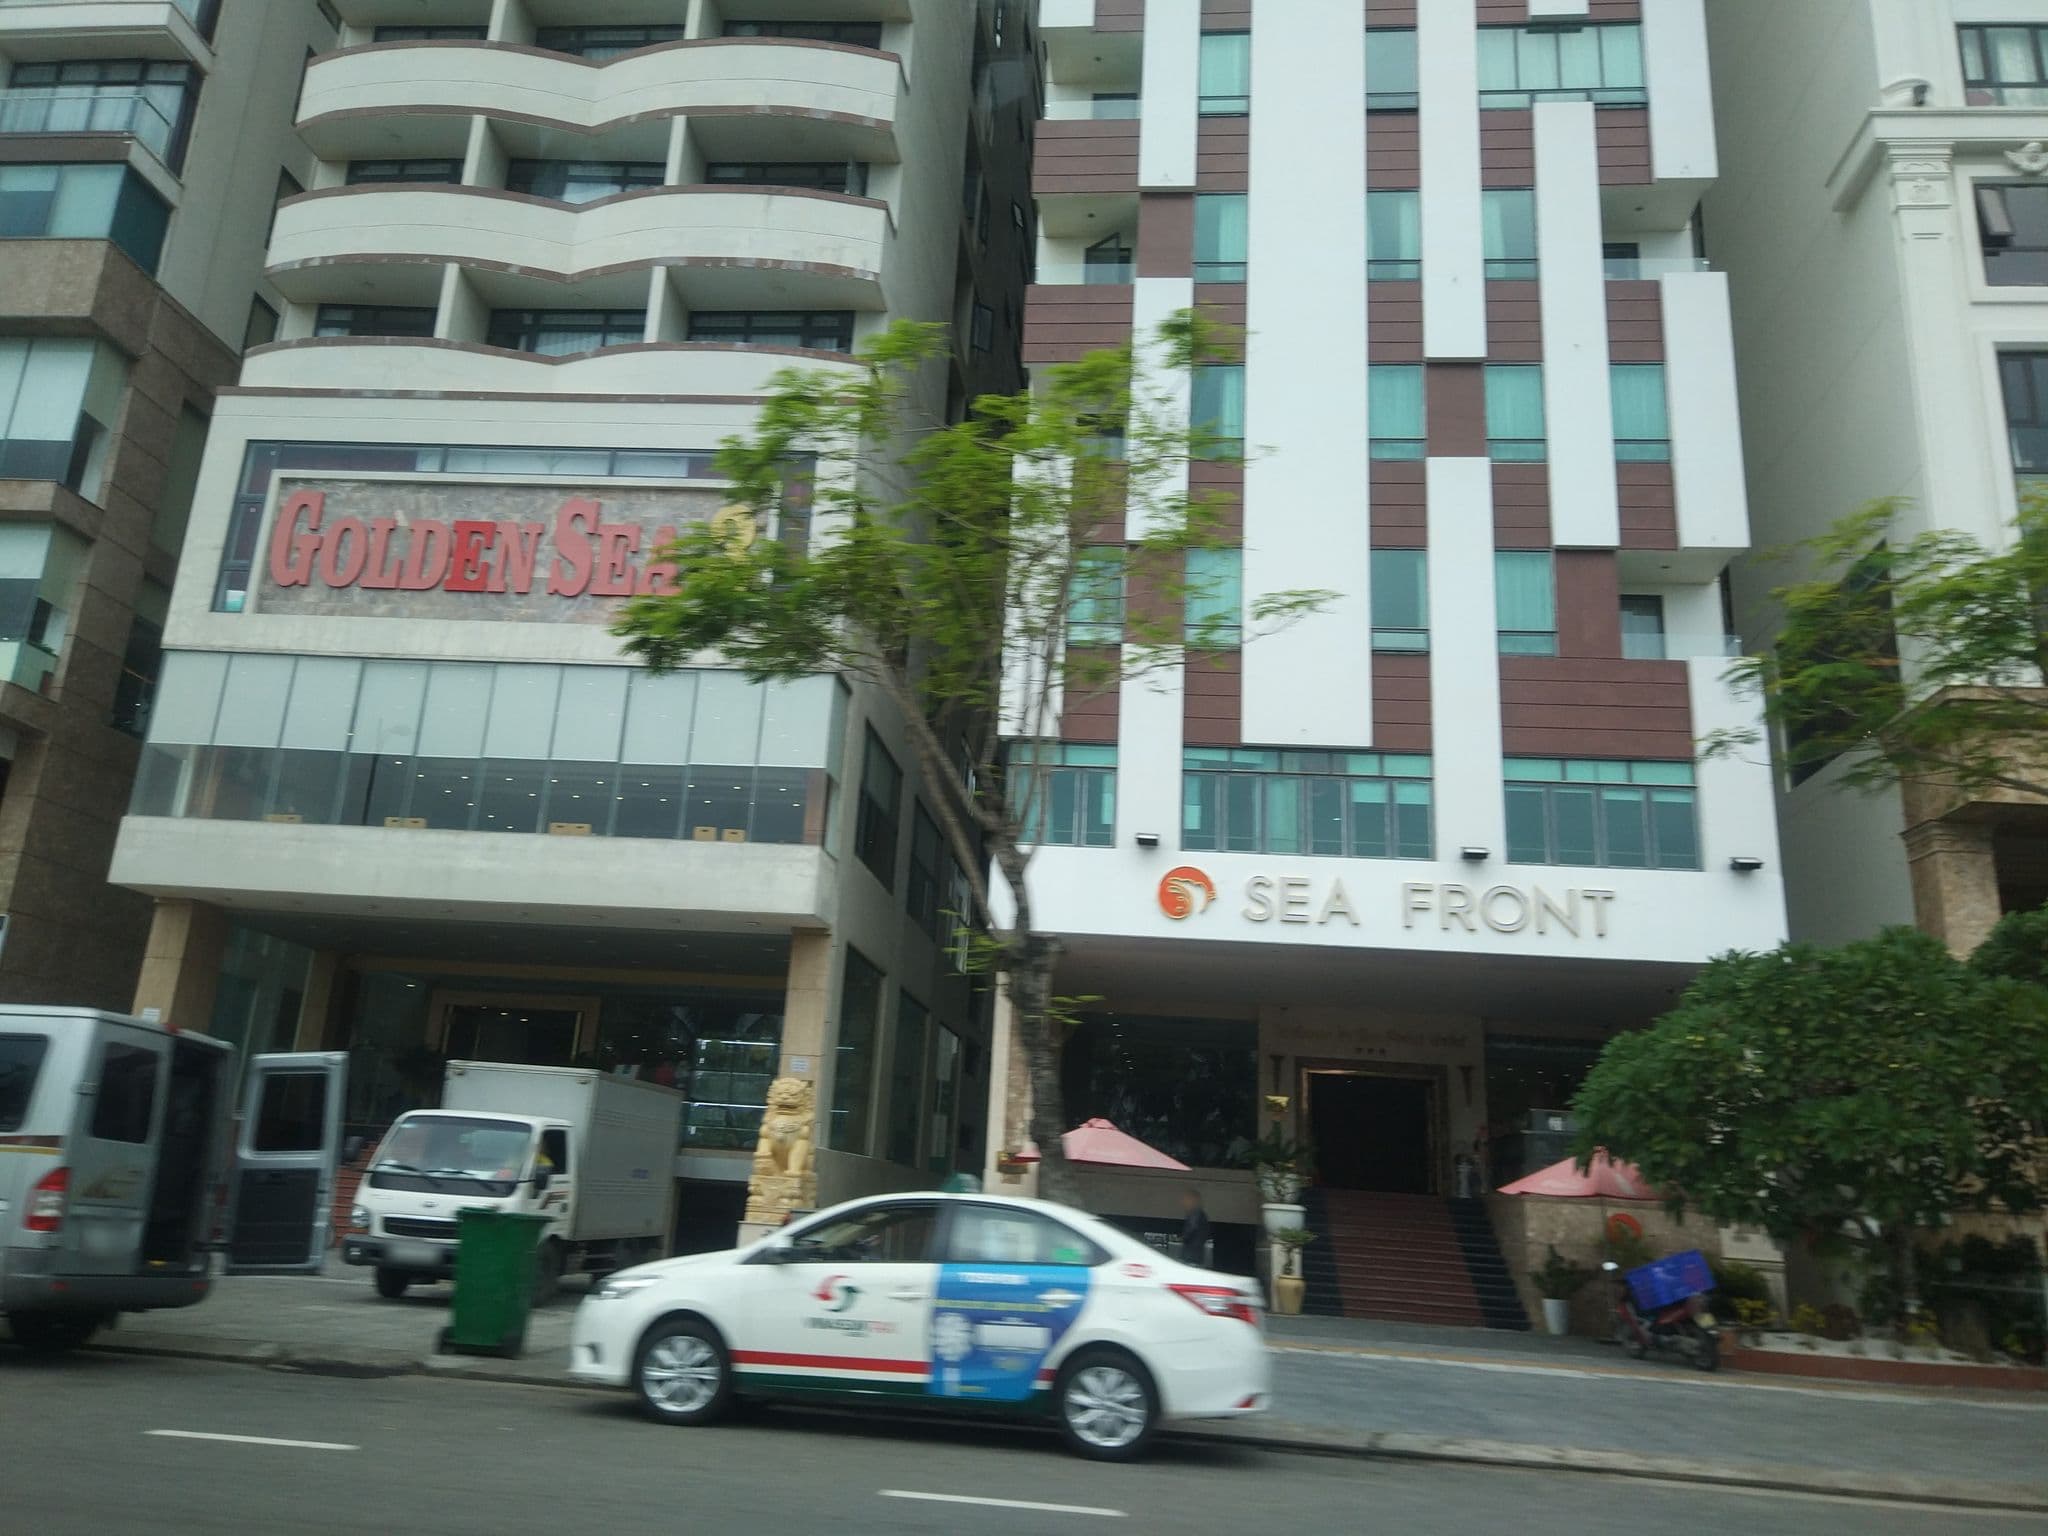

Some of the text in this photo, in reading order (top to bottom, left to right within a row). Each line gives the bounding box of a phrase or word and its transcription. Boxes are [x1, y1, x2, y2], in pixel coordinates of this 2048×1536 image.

[269, 490, 545, 594] GOLDEN
[1241, 875, 1616, 938] SEA FRONT
